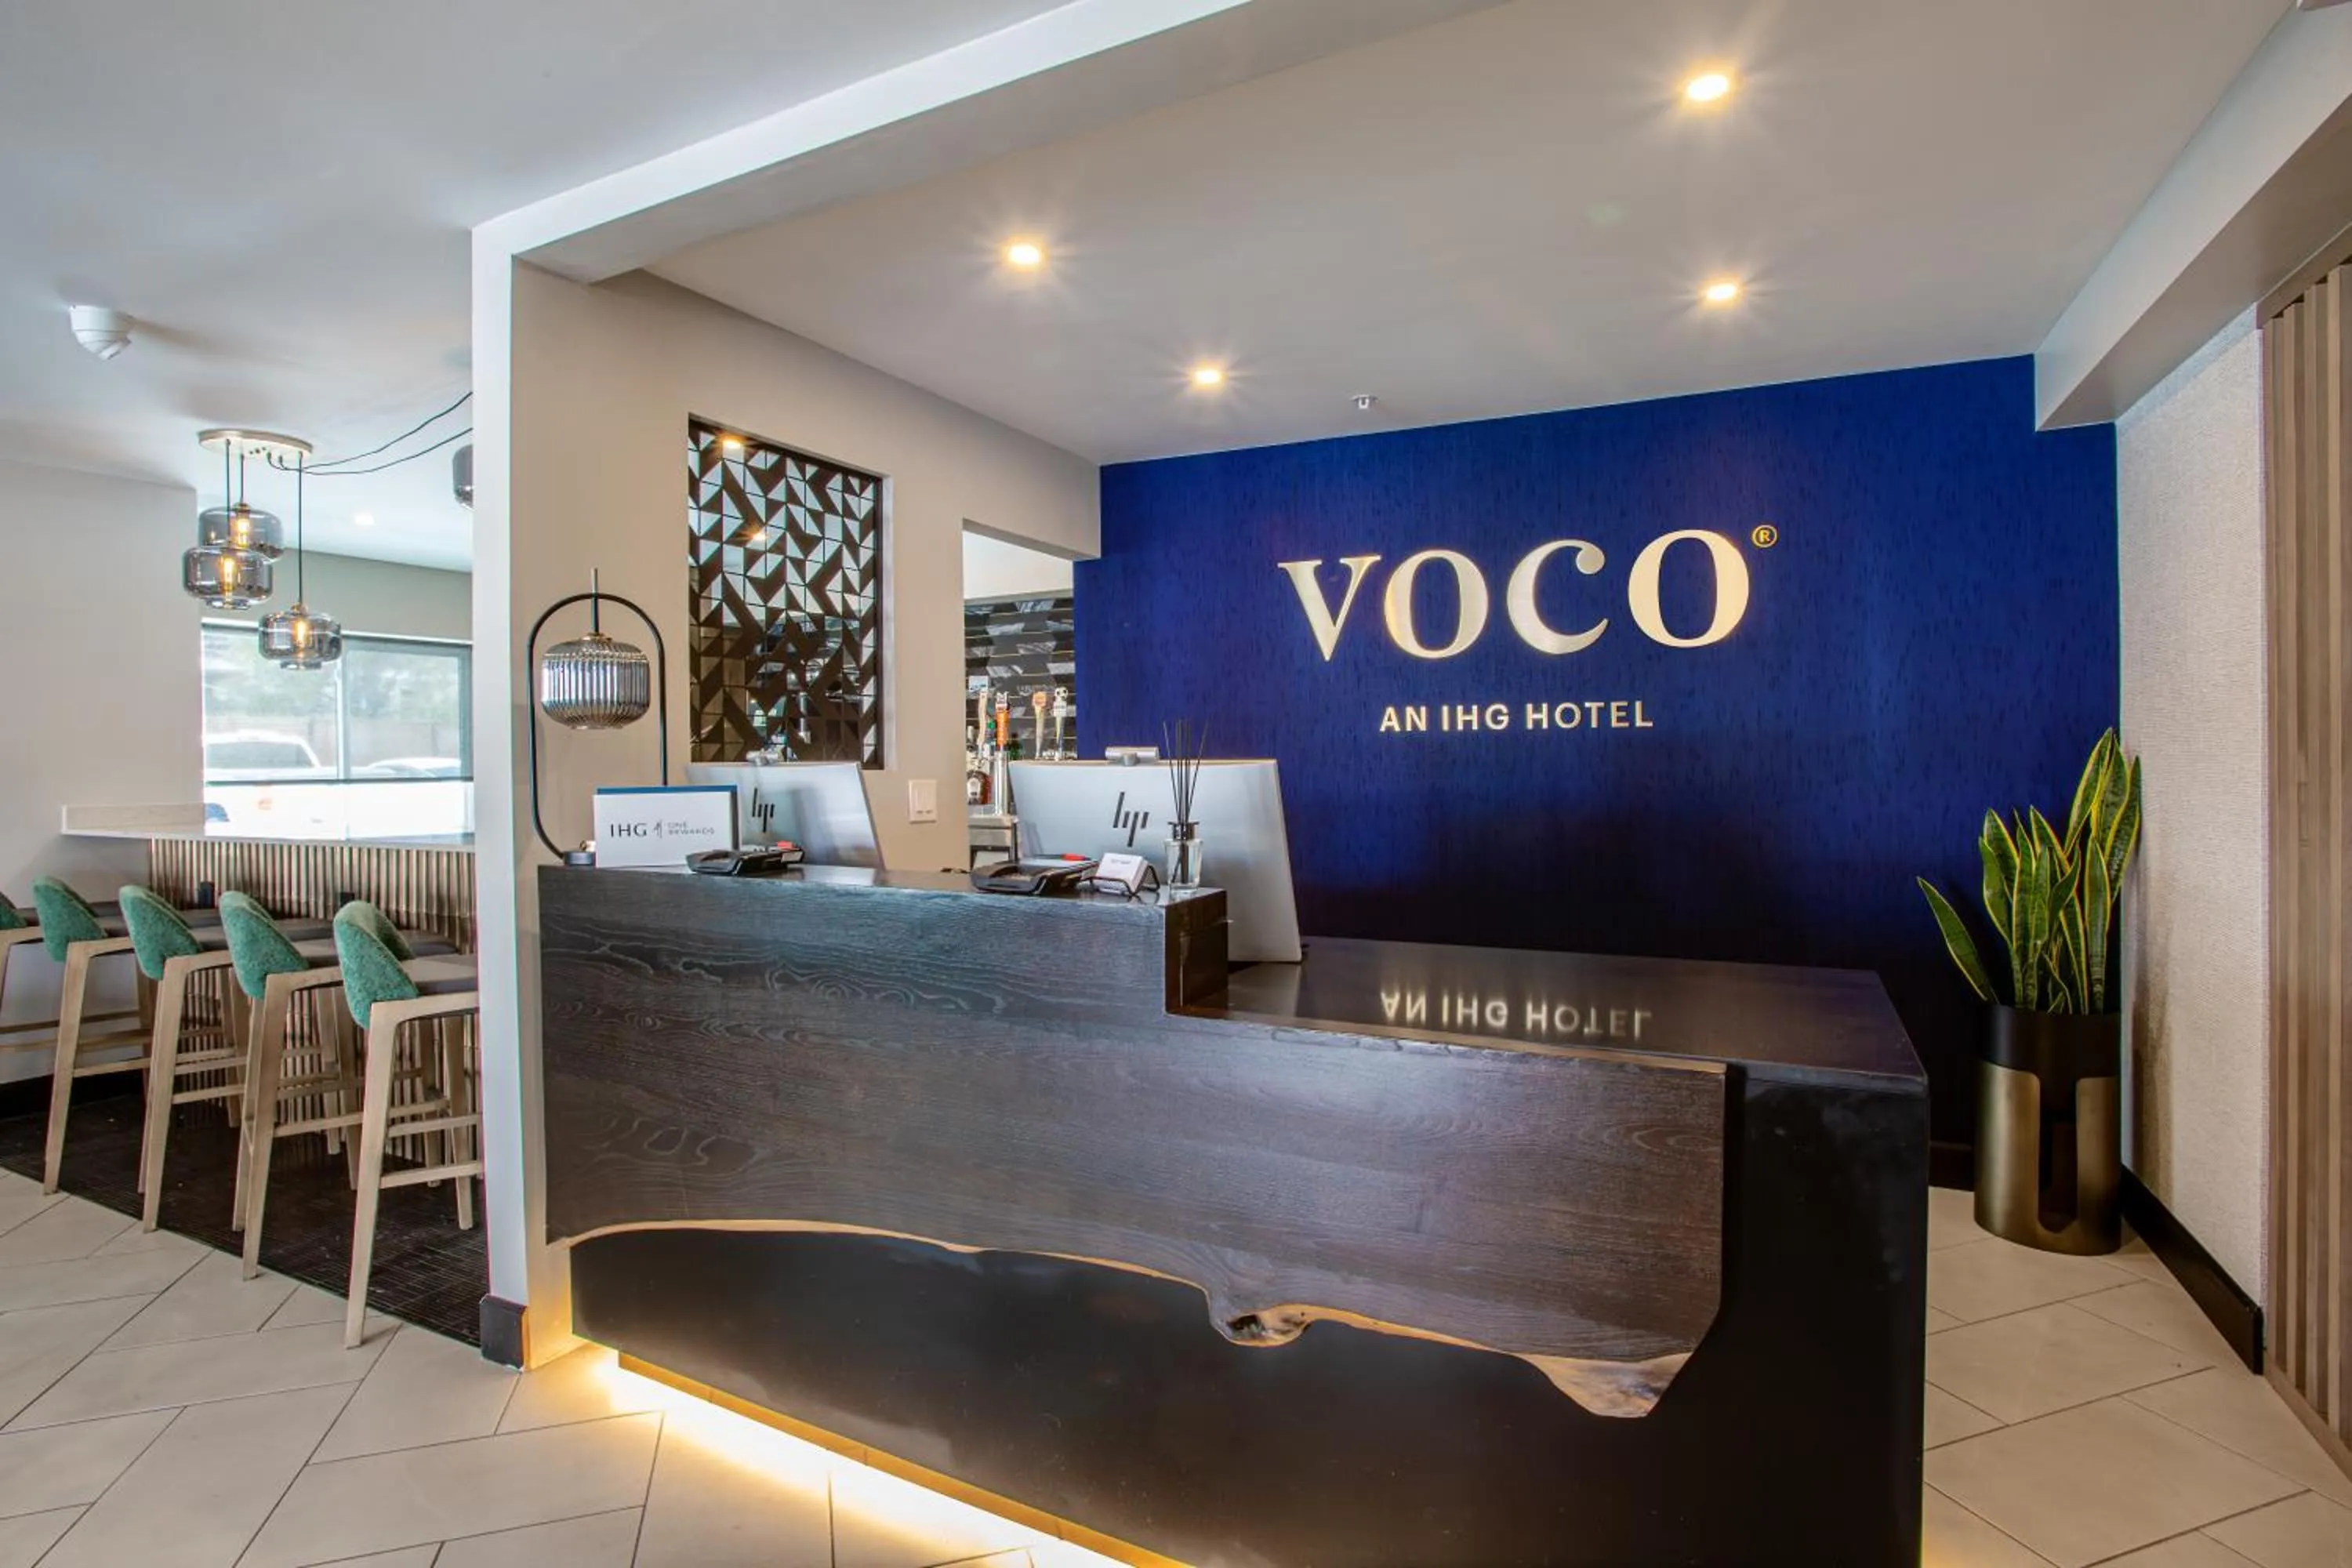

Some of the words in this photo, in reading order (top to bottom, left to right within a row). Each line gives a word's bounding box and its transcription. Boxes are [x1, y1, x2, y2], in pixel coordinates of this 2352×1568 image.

[1378, 705, 1428, 732] AN
[1440, 703, 1510, 732] IHG
[1525, 700, 1654, 731] HOTEL
[610, 823, 648, 837] IHG
